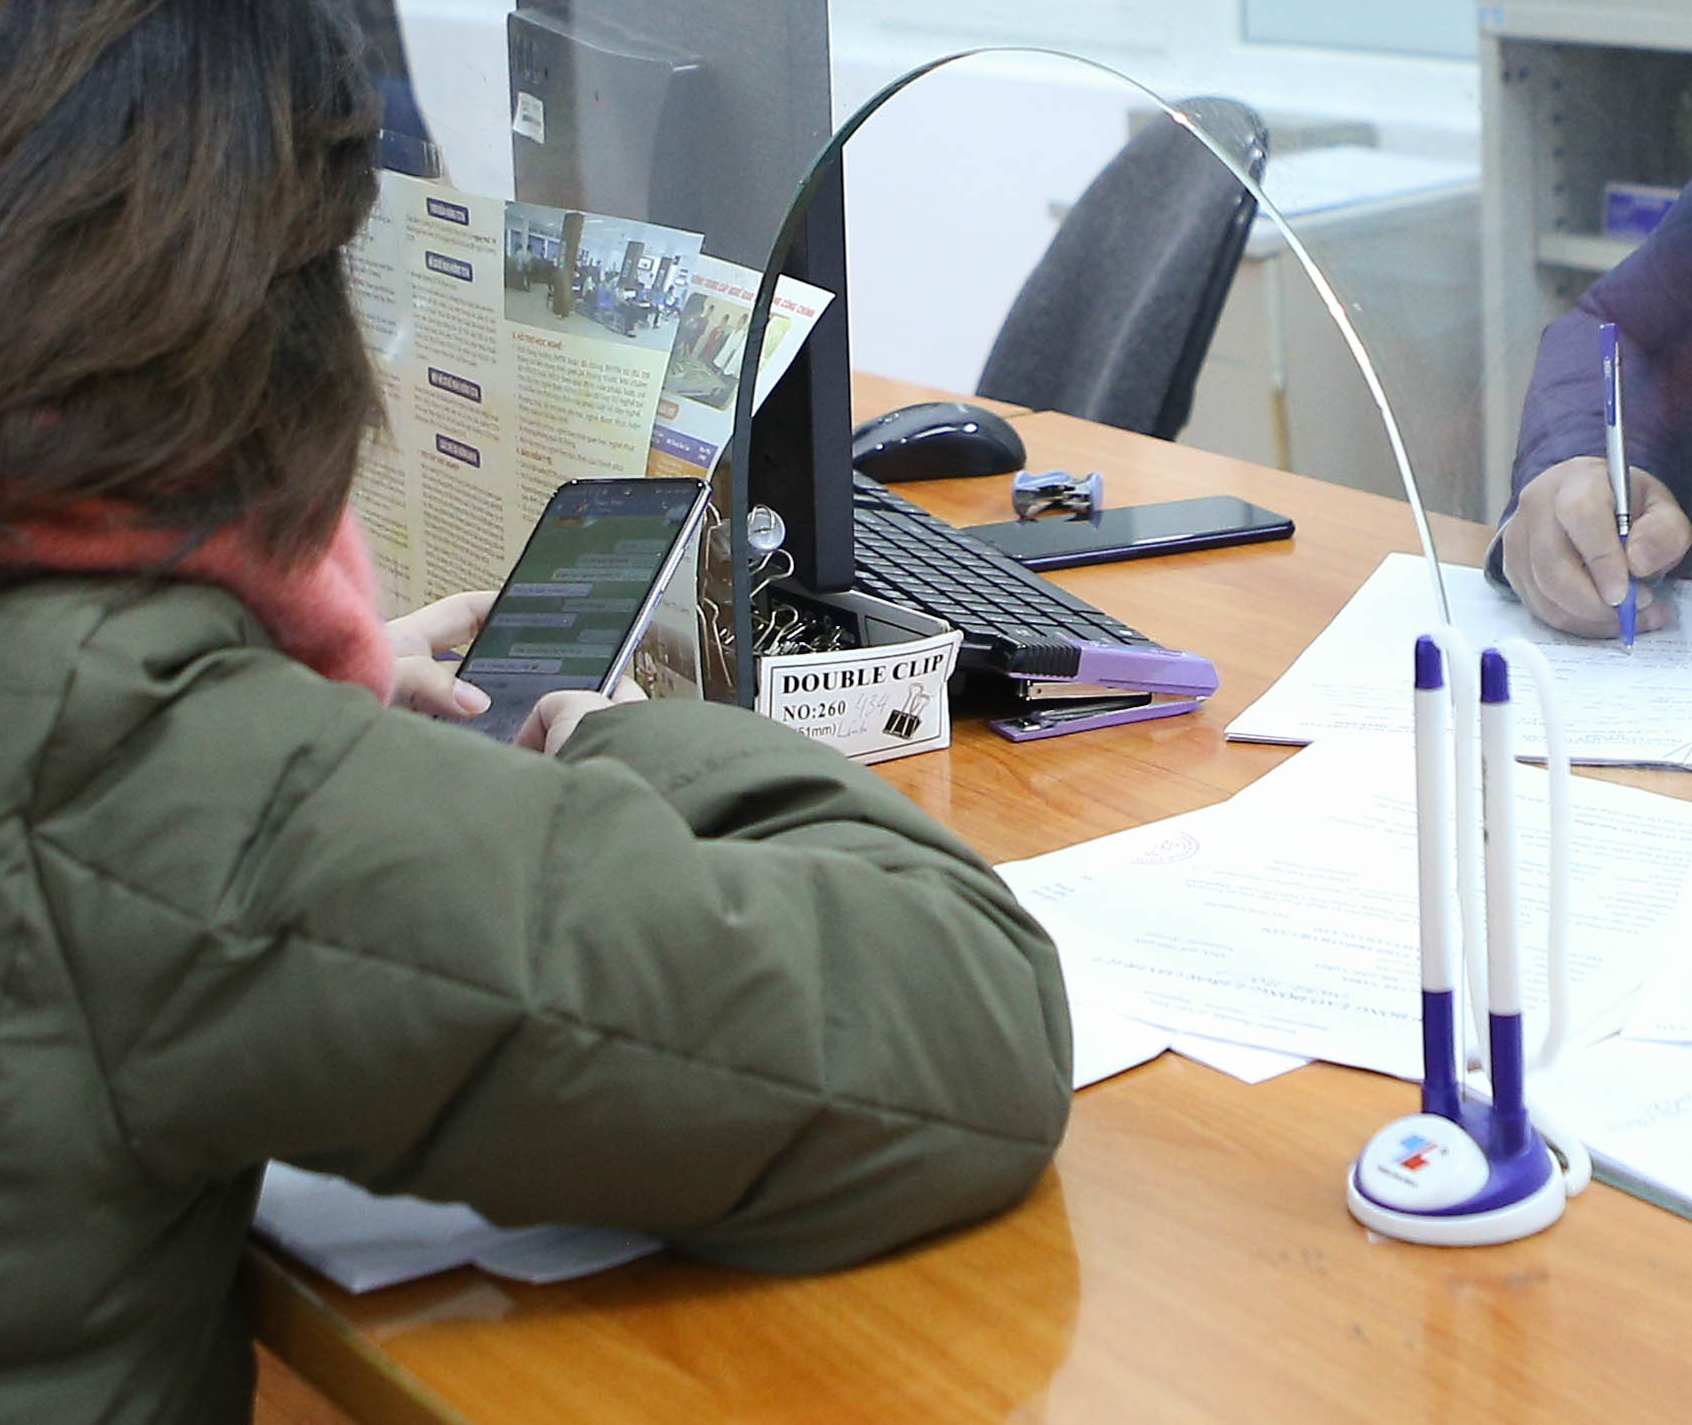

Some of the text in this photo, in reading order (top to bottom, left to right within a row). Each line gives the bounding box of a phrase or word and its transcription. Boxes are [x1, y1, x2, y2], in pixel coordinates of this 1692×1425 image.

[782, 653, 945, 695] DOUBLE CLIP
[782, 700, 847, 722] NO:260
[795, 722, 837, 738] 51mm)
